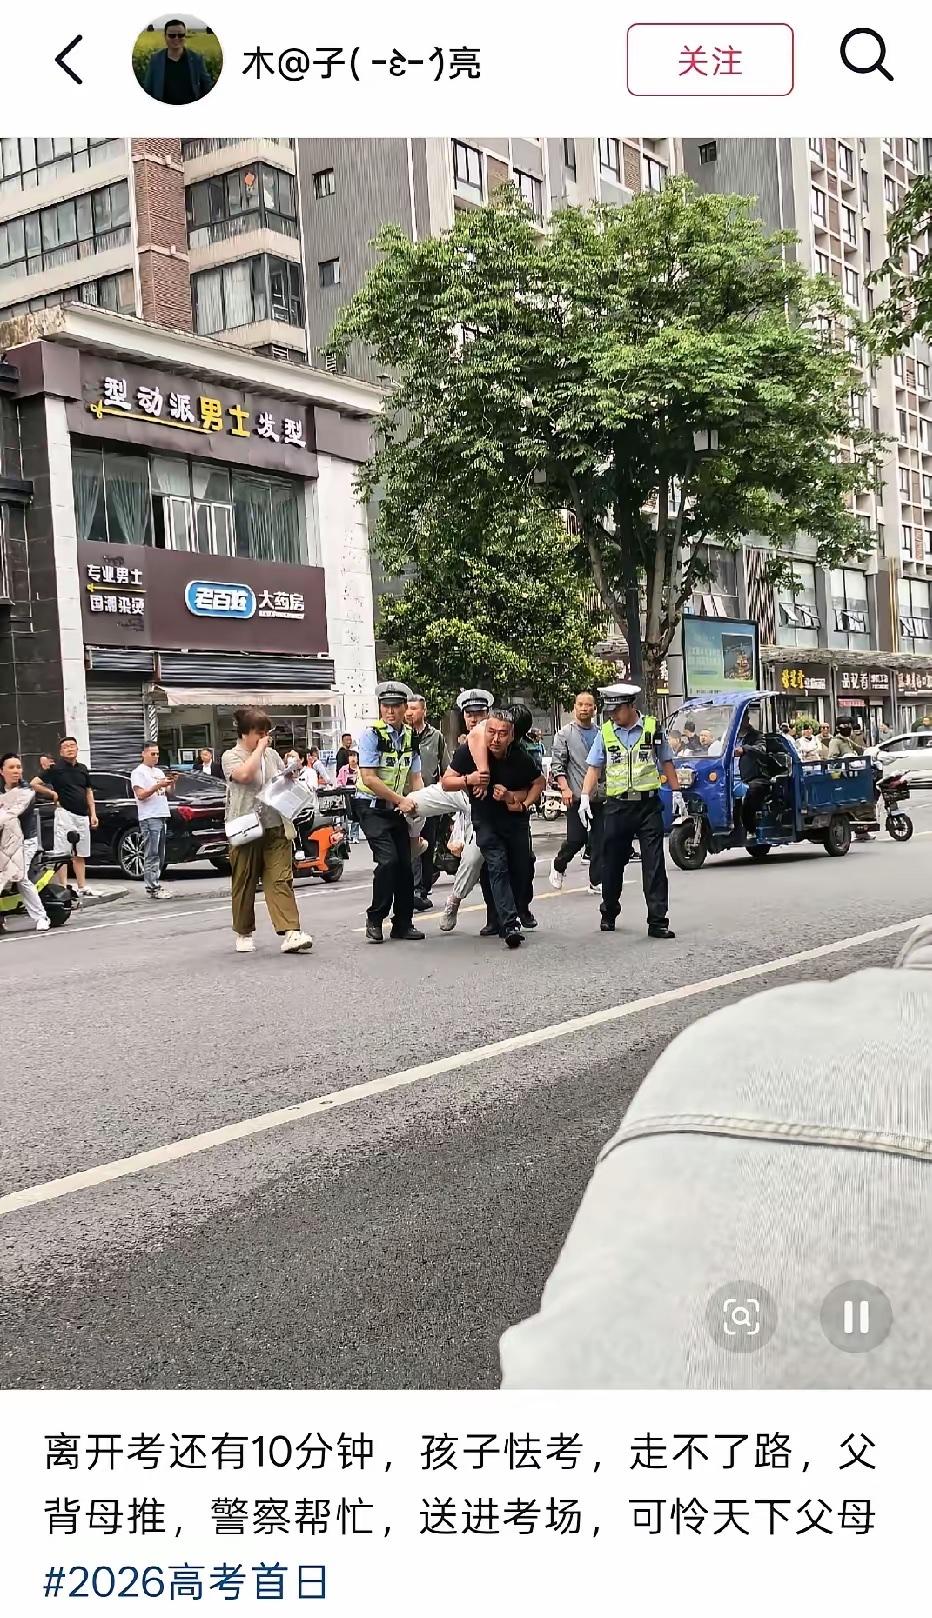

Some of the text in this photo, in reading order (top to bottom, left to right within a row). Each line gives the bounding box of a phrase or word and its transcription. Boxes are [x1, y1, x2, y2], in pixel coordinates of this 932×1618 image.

[104, 376, 306, 448] 型动派男士发型
[87, 564, 143, 585] 专业男士
[259, 589, 305, 611] 大药房
